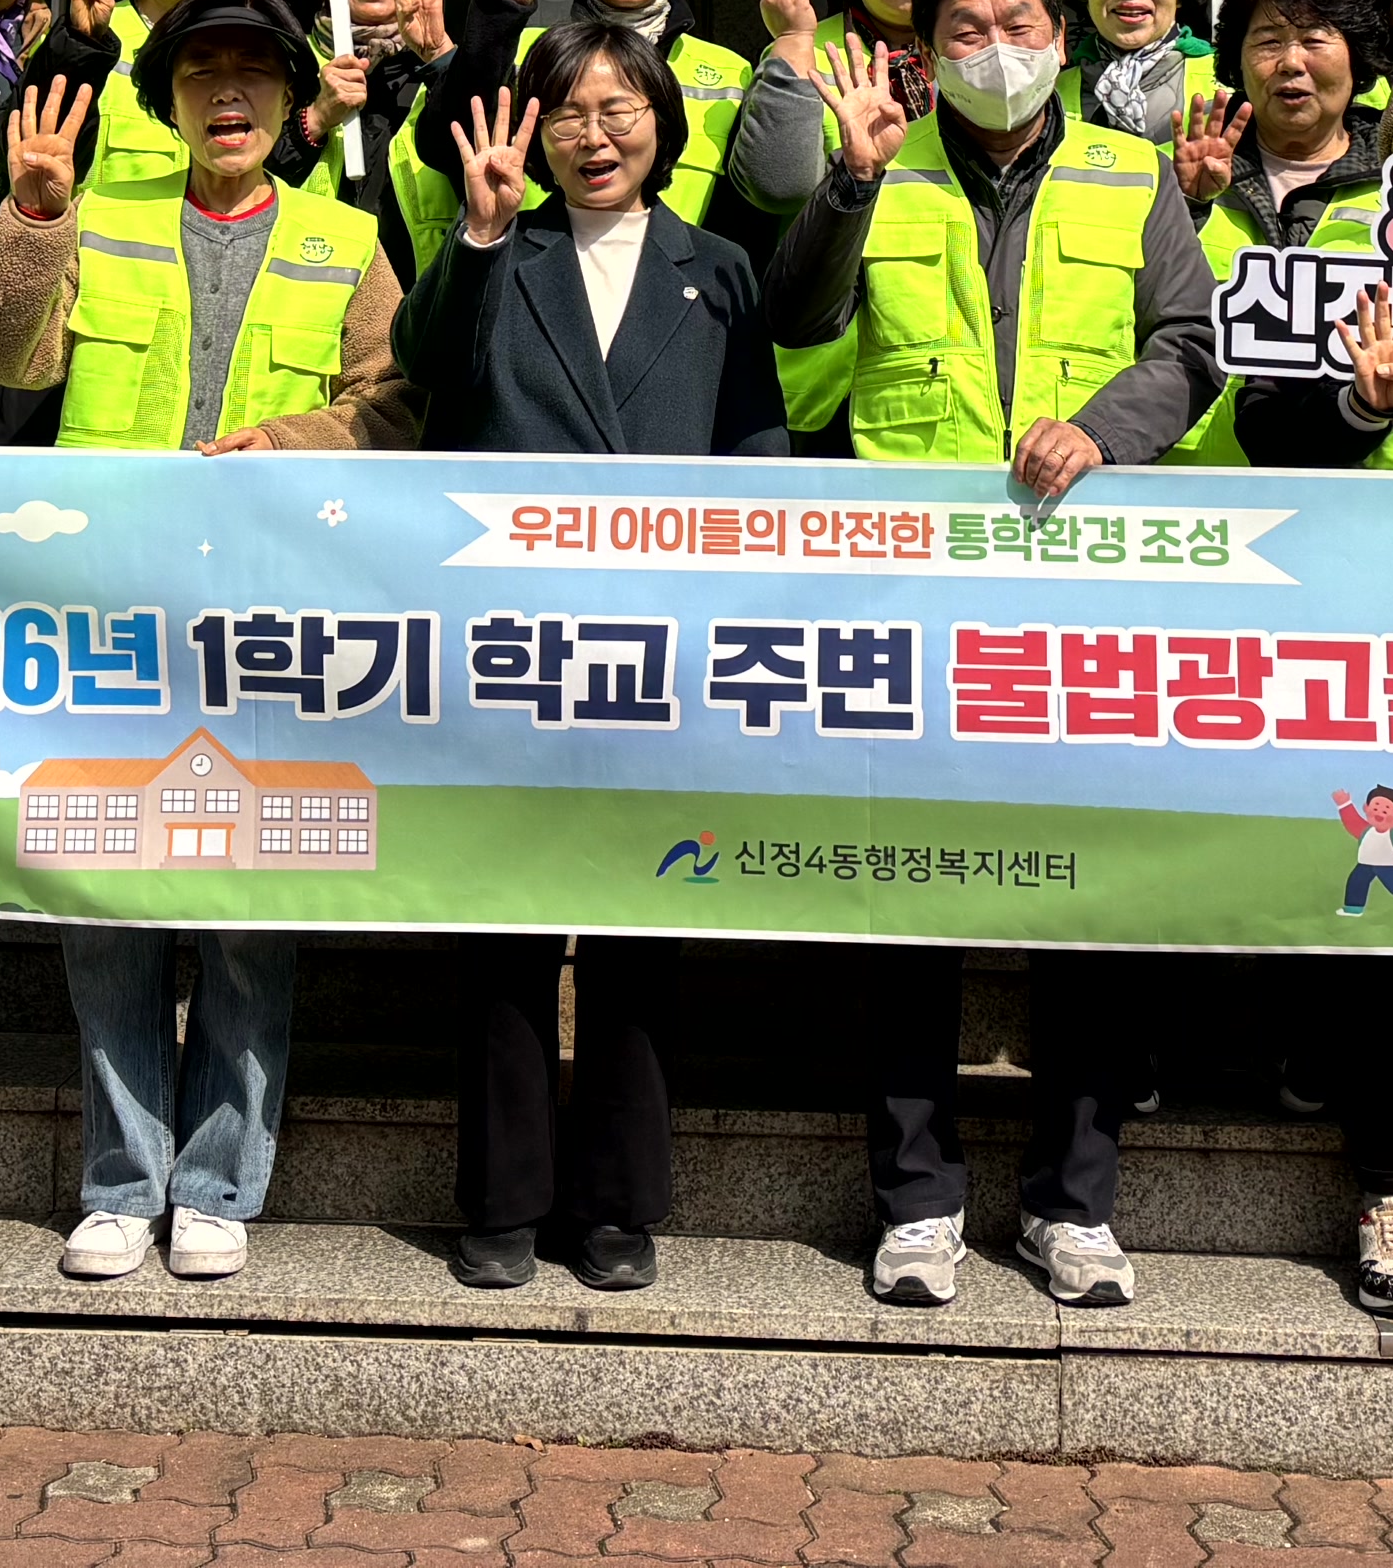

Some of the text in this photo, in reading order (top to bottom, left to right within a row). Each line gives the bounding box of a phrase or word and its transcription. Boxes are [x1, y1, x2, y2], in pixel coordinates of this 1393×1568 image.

[509, 505, 1232, 567] 우리 아이들의 안전한 통학환경 조성
[191, 613, 431, 717] 1학기
[470, 618, 671, 723] 학교
[708, 627, 914, 730] 주변
[734, 840, 1078, 890] 신정4동행정복지센터
